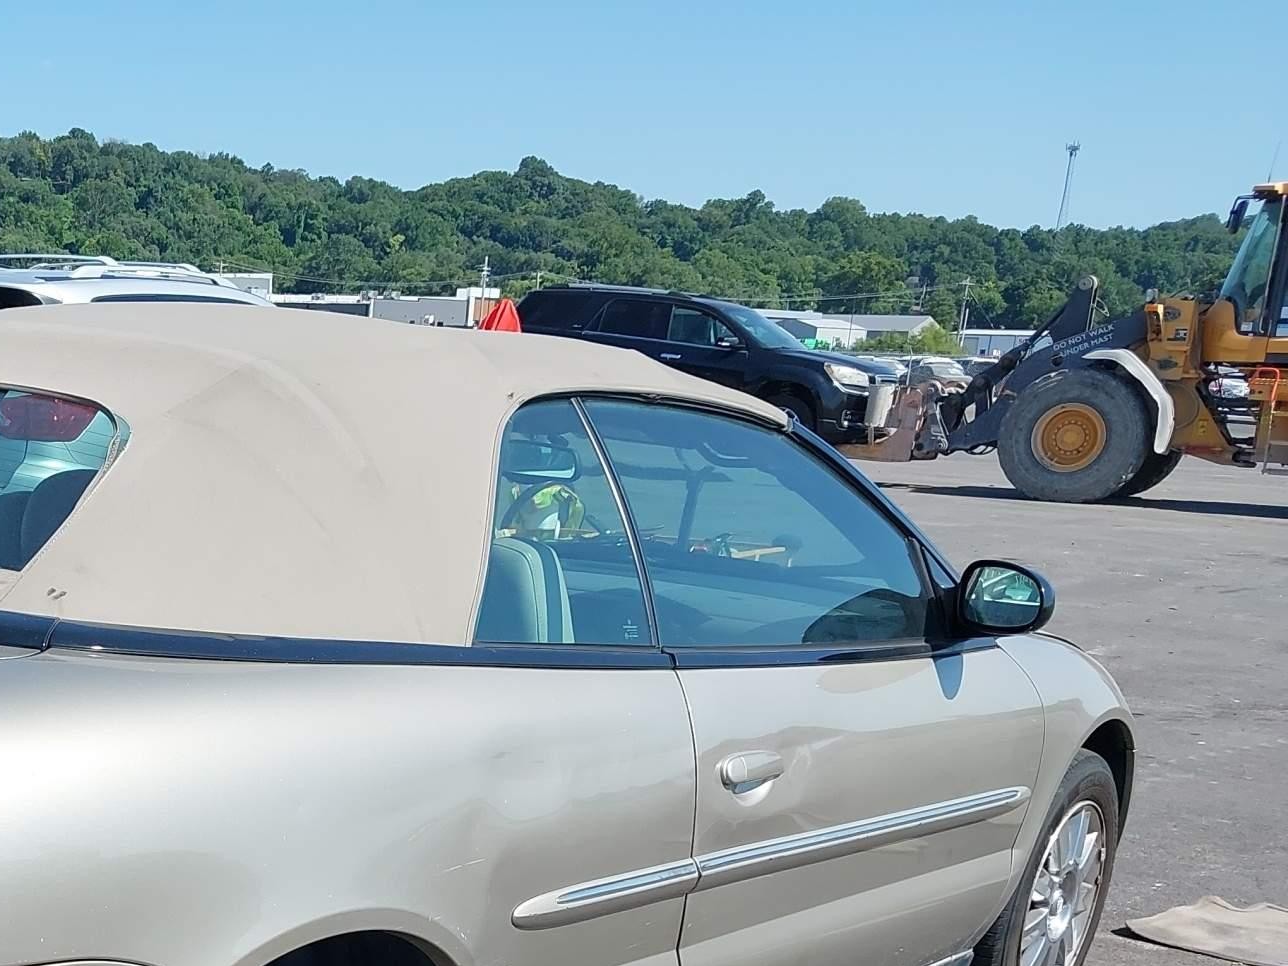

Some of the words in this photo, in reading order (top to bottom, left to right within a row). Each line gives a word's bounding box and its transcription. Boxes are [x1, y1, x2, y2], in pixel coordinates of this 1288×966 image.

[1053, 341, 1067, 351] DO
[1068, 334, 1086, 345] NOT
[1088, 324, 1115, 337] WALK
[1060, 342, 1090, 357] UNDER
[1091, 333, 1113, 346] MAST
